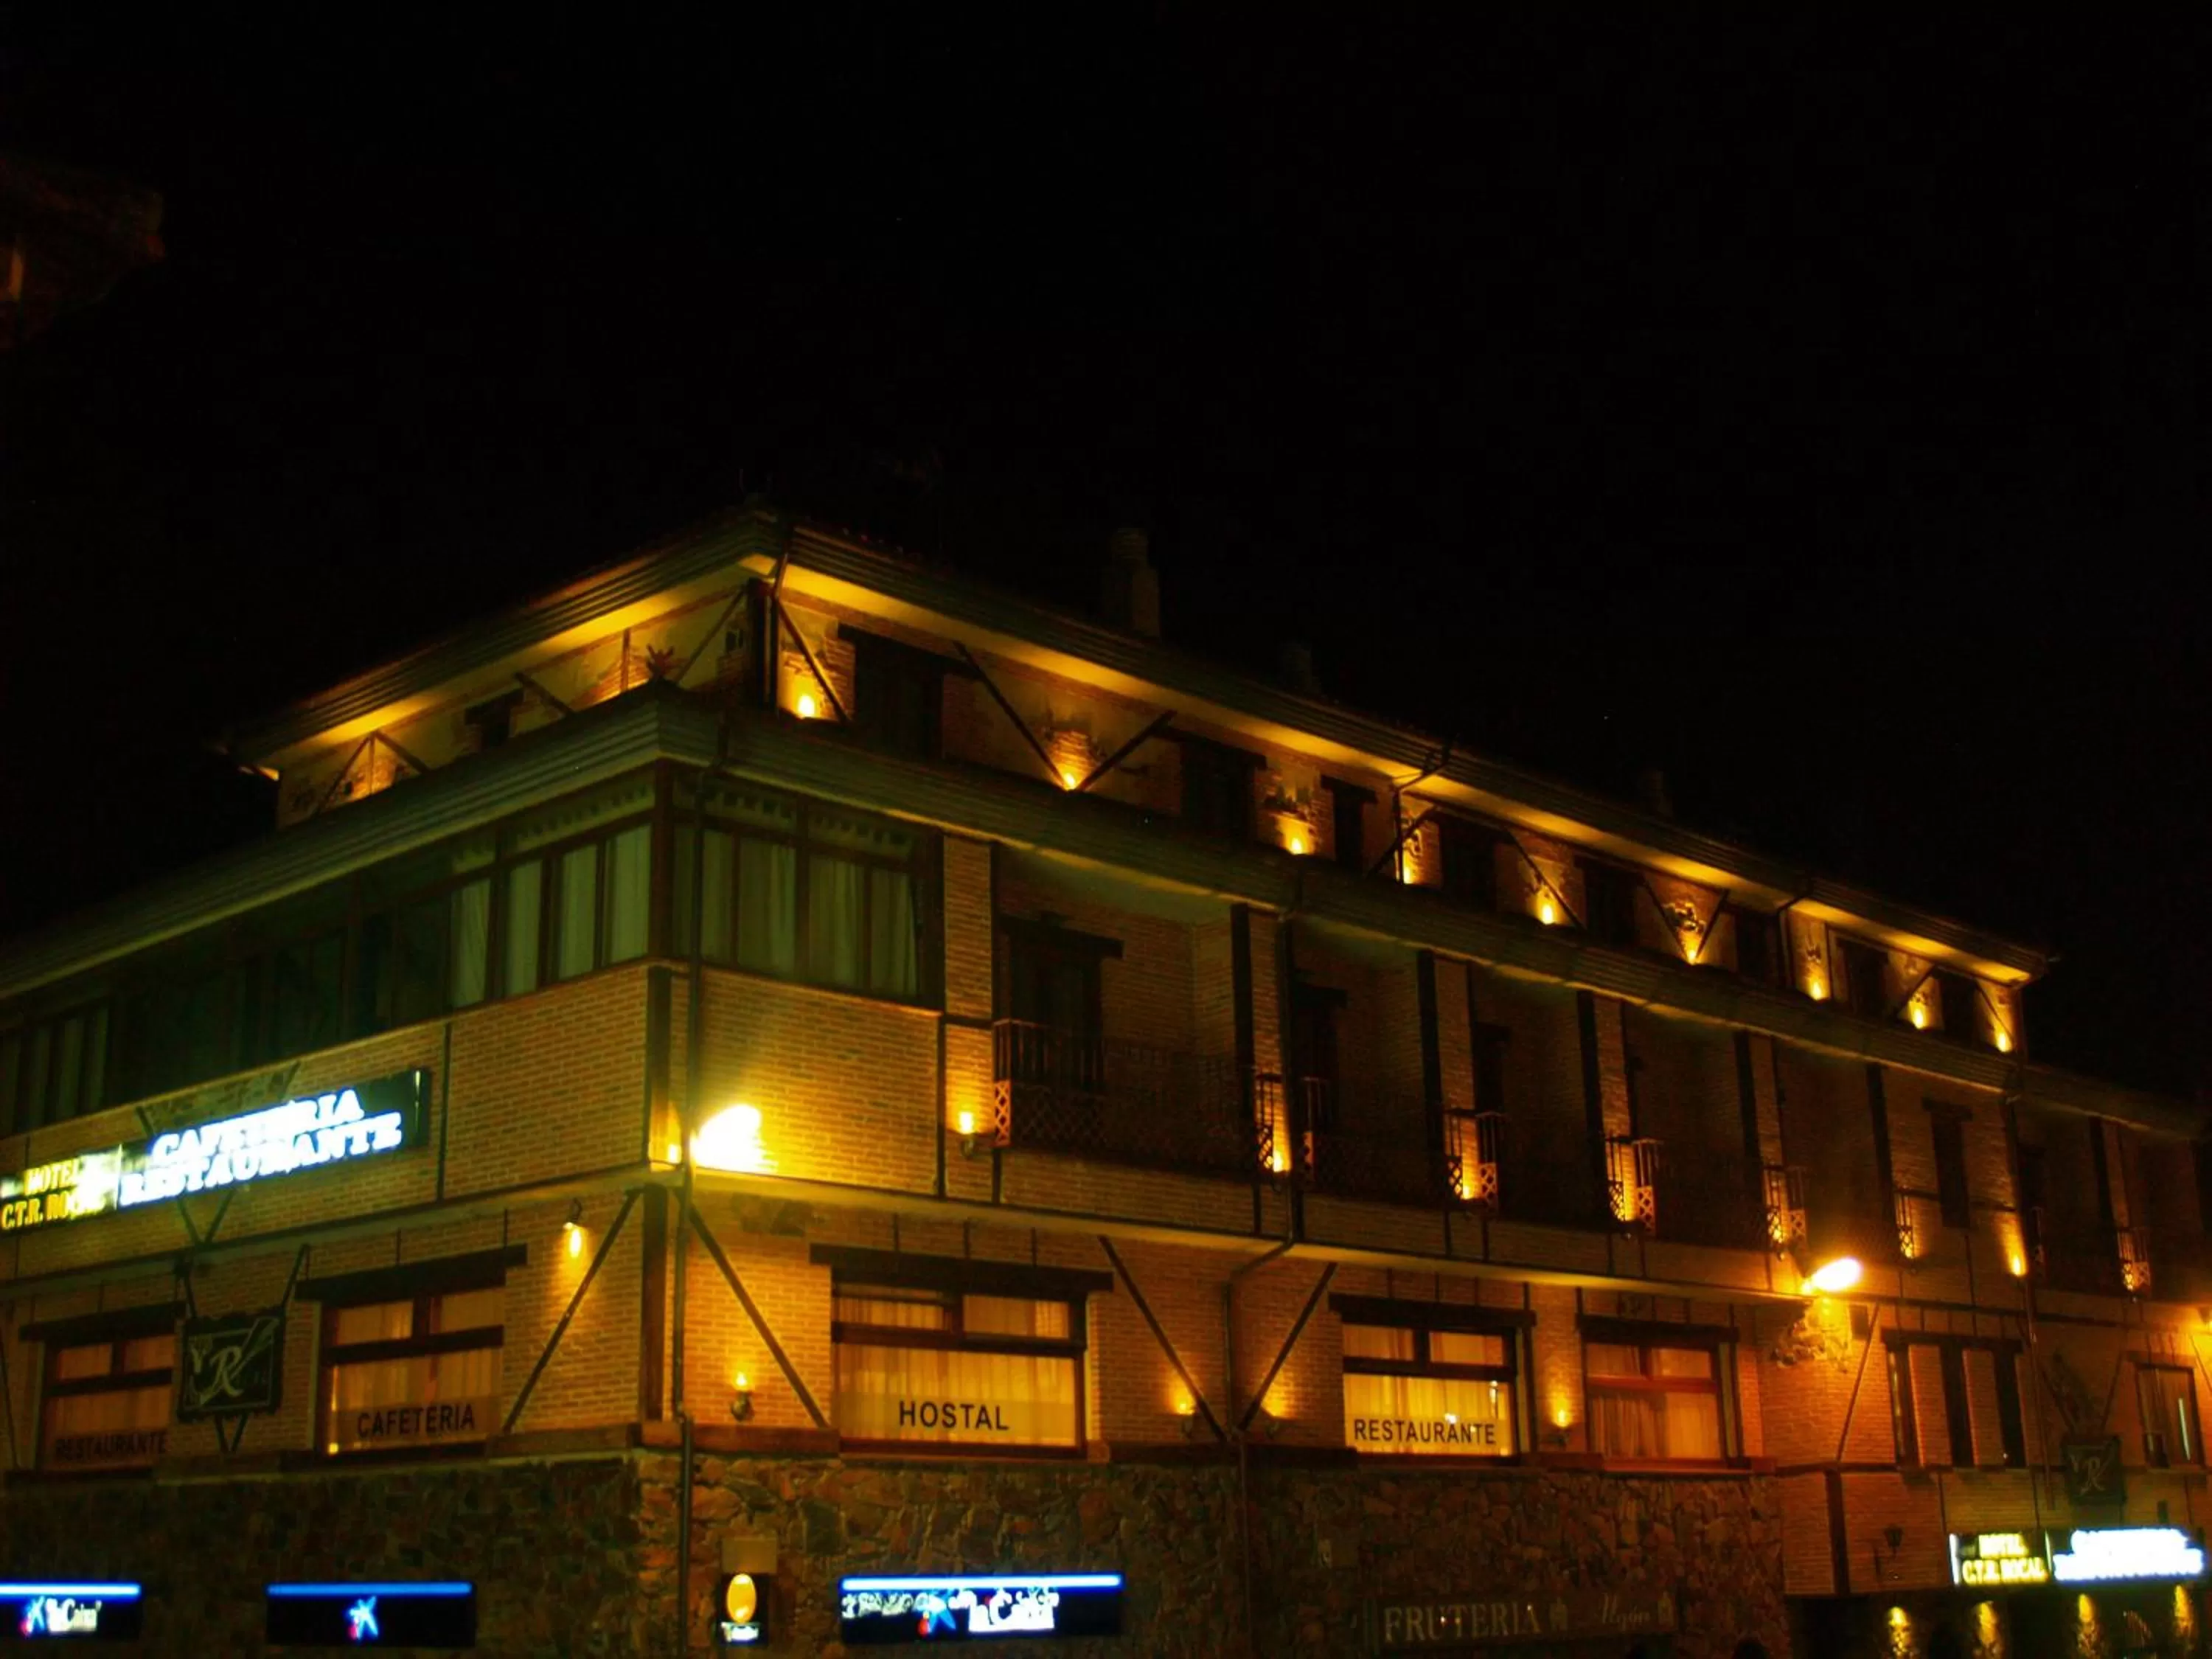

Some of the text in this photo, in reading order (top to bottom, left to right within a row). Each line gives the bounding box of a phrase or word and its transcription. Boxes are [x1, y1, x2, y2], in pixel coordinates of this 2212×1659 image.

[121, 1113, 402, 1205] RESTAURANTE
[357, 1402, 476, 1439] CAFETERIA
[898, 1400, 1010, 1431] HOSTAL
[55, 1430, 168, 1461] RESTAURANTE
[1353, 1418, 1497, 1445] RESTAURANTE
